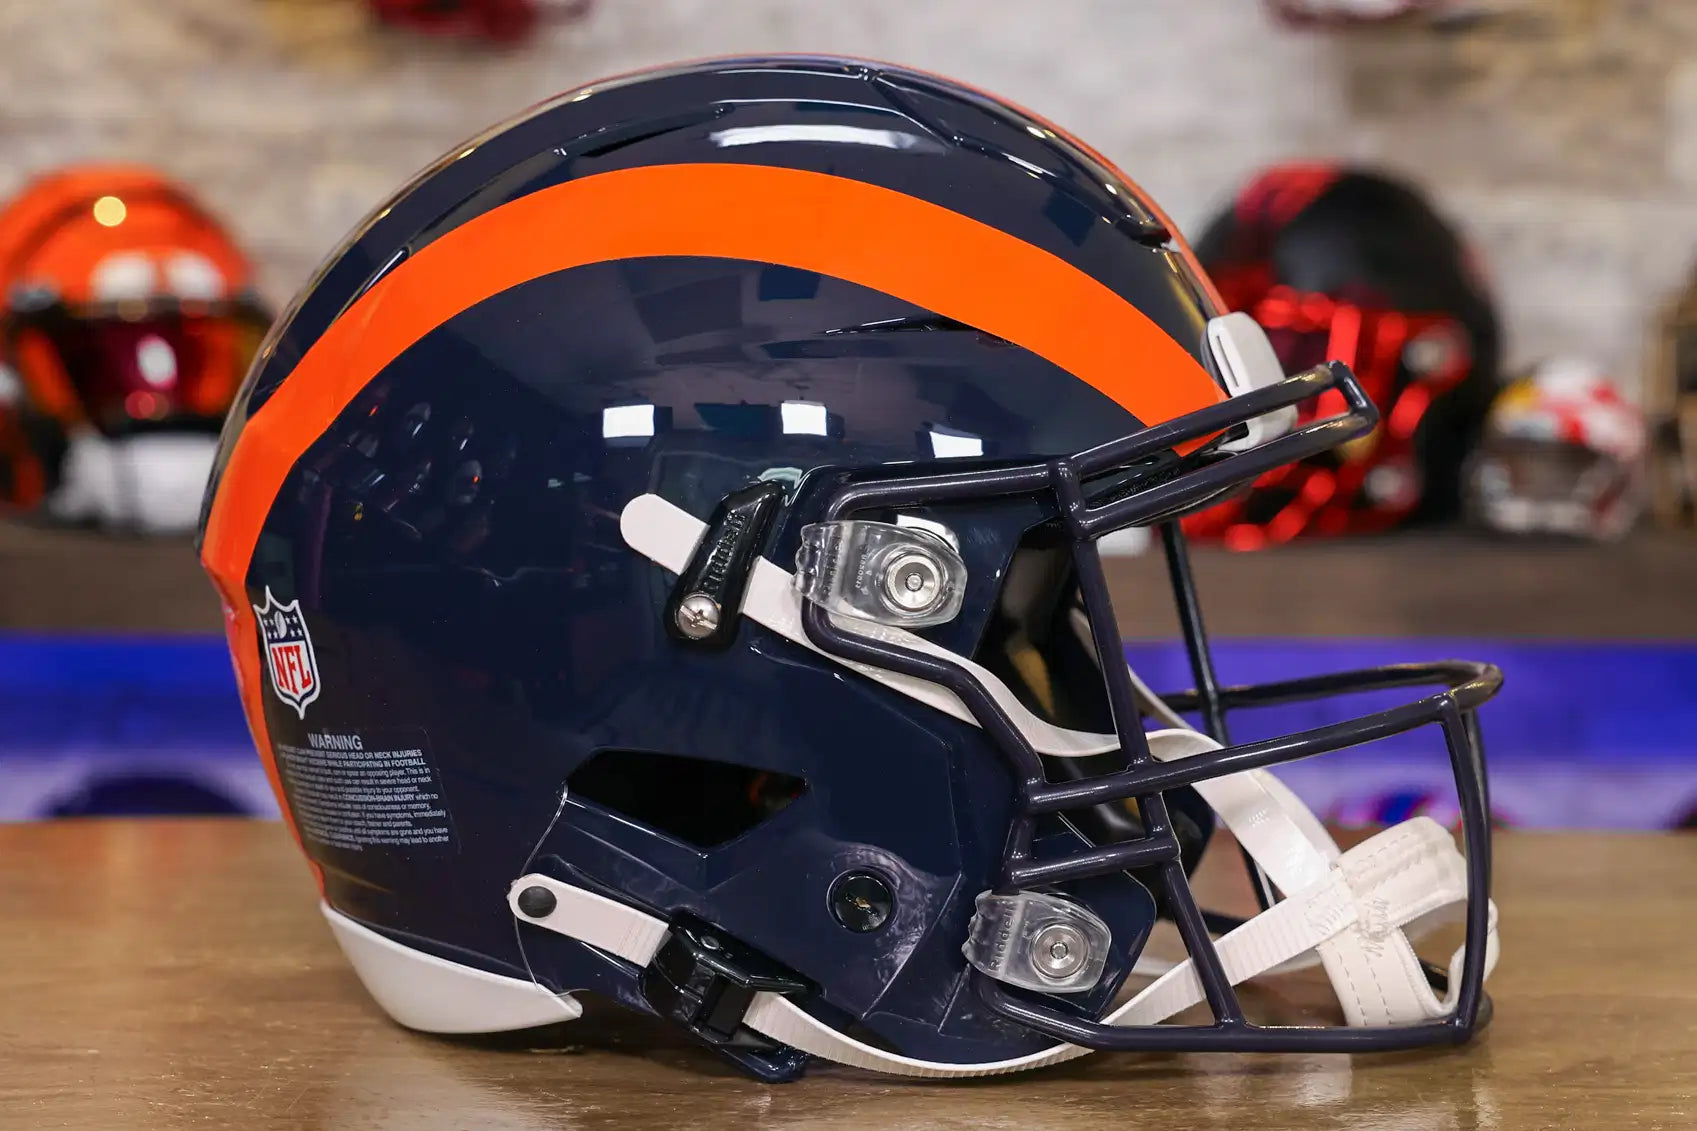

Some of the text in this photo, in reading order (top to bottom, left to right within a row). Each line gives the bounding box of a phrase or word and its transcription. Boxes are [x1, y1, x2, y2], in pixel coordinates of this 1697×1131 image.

[272, 644, 313, 696] NFL
[307, 732, 364, 751] WARNING
[348, 752, 364, 760] HEAD
[364, 752, 374, 760] OR
[374, 751, 392, 760] NECK
[392, 749, 423, 759] INJURIES
[405, 767, 418, 775] This
